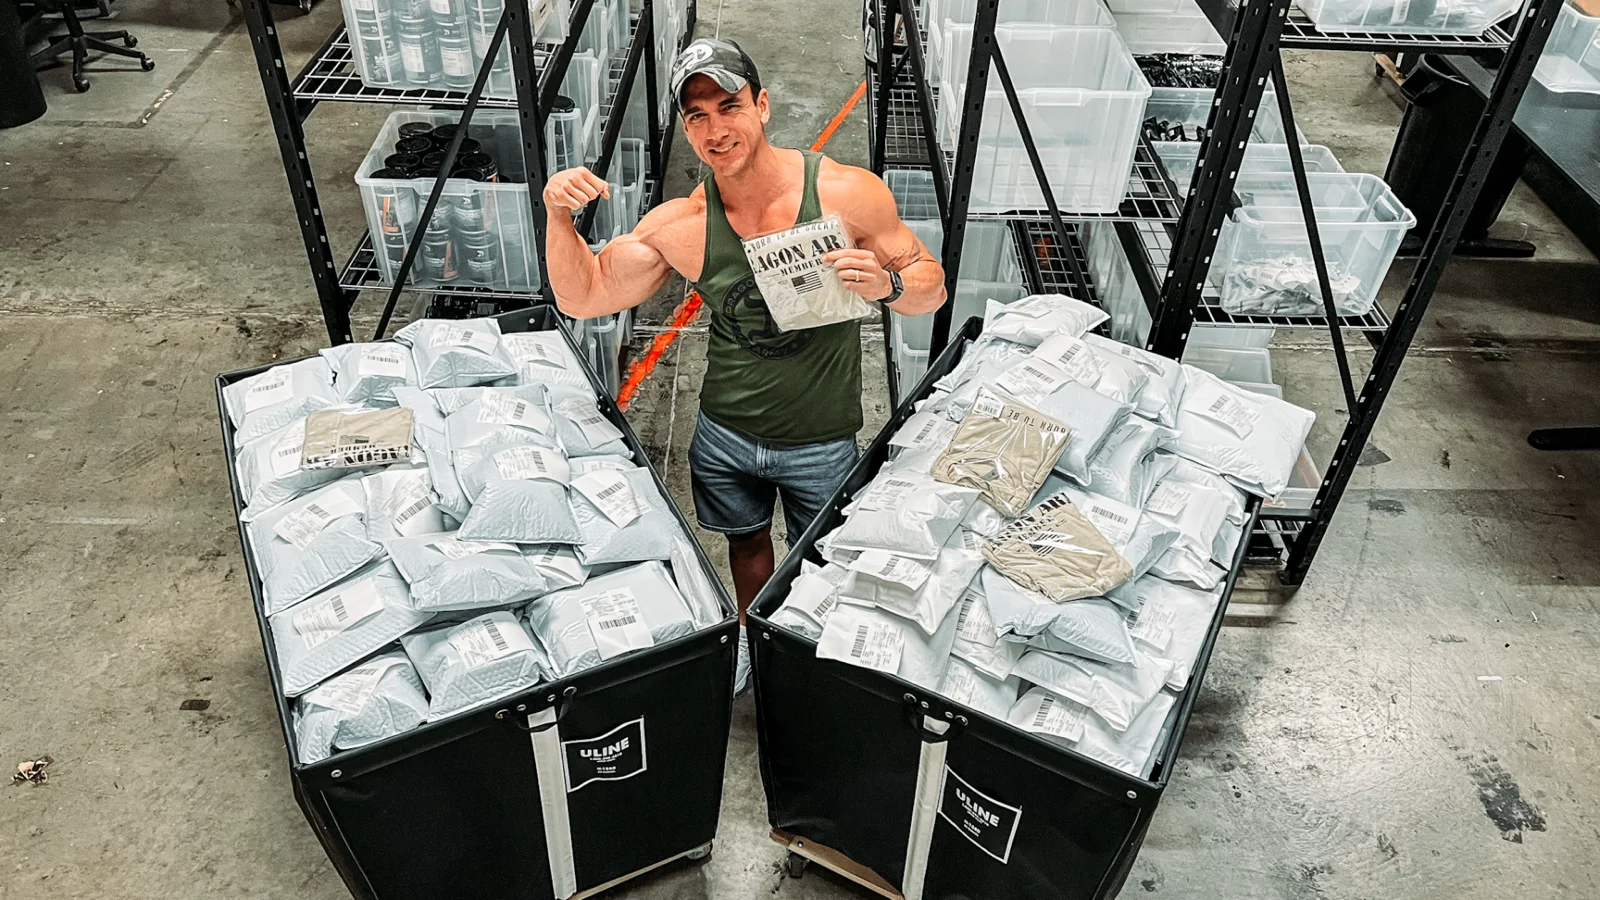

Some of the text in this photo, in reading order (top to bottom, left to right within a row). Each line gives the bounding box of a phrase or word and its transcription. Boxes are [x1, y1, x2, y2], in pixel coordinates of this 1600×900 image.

[811, 234, 847, 257] AR
[780, 258, 823, 276] MEMBER
[724, 279, 756, 314] DRAGO
[1007, 409, 1020, 421] BE
[1037, 492, 1072, 516] AR
[579, 736, 630, 758] ULINE
[955, 787, 1000, 827] ULINE
